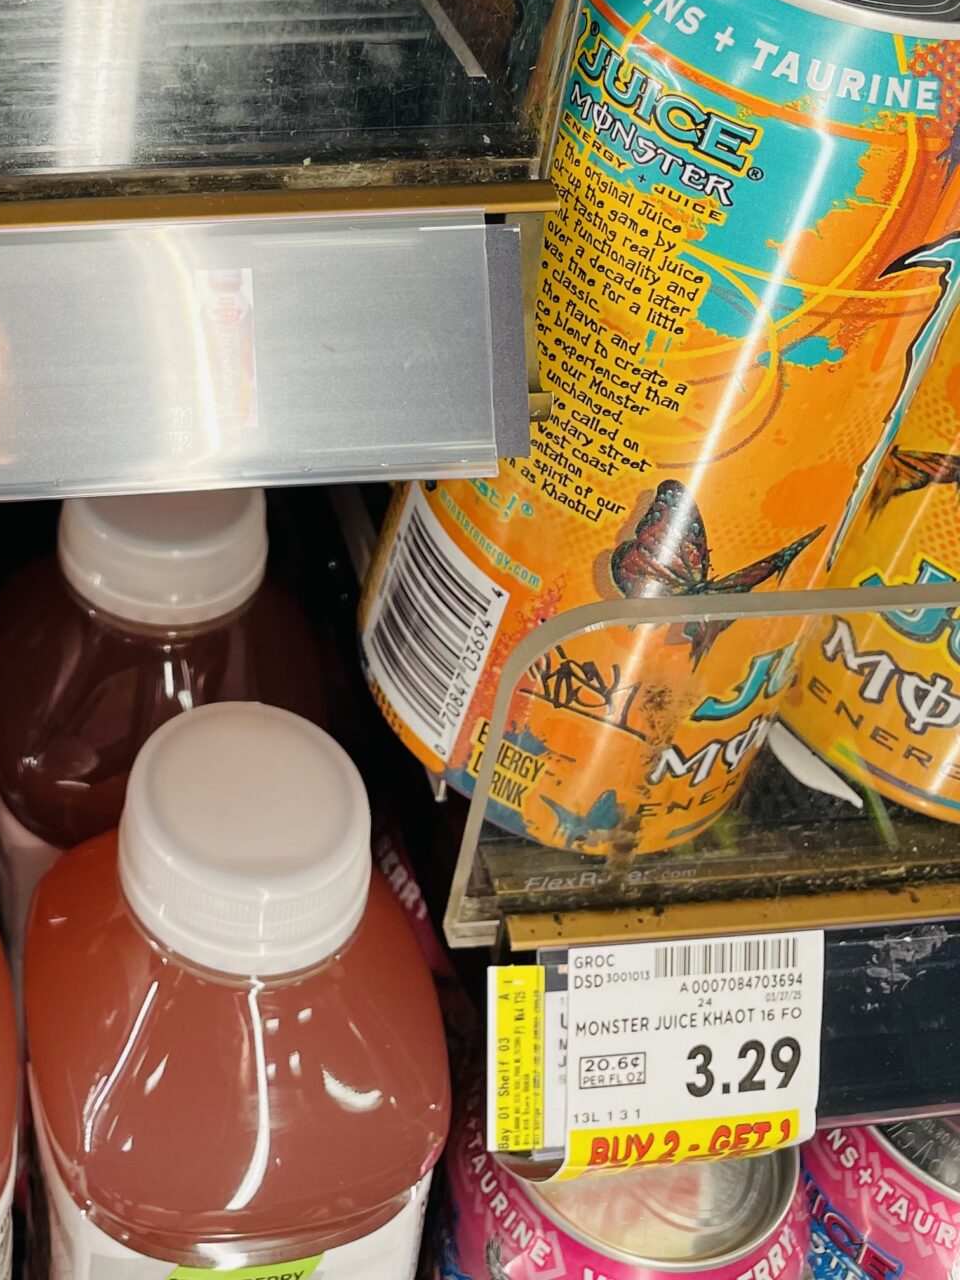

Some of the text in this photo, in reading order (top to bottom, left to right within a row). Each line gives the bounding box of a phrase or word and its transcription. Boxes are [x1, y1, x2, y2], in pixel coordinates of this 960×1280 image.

[751, 38, 939, 111] TAURINE
[578, 38, 761, 170] JUICE
[564, 113, 627, 168] ENERGY
[585, 168, 681, 233] original Juice
[655, 186, 723, 221] JUICE
[573, 196, 704, 284] tasting real juice
[575, 220, 661, 286] functionality
[608, 209, 676, 253] game by
[552, 269, 600, 313] classic
[590, 255, 690, 317] decade later
[646, 308, 684, 335] little
[554, 337, 679, 412] experienced than
[615, 356, 668, 387] create
[546, 369, 623, 426] unchanged.
[590, 376, 650, 418] Monster
[572, 449, 619, 476] coast
[598, 443, 652, 472] street
[574, 954, 615, 968] GROC
[574, 971, 650, 989] DSD 3001013
[692, 973, 803, 994] 0007084703694
[765, 991, 802, 1002] 03/27/25
[576, 1007, 802, 1037] MONSTER JUICE KHAOT 16 FO
[583, 1072, 642, 1085] PER FL OZ
[585, 1037, 801, 1098] 20.6¢ 3.29
[498, 1037, 512, 1150] Bay 01 Shelf 03
[588, 1122, 769, 1167] BUY 2 GET
[468, 1132, 551, 1266] TAURINE
